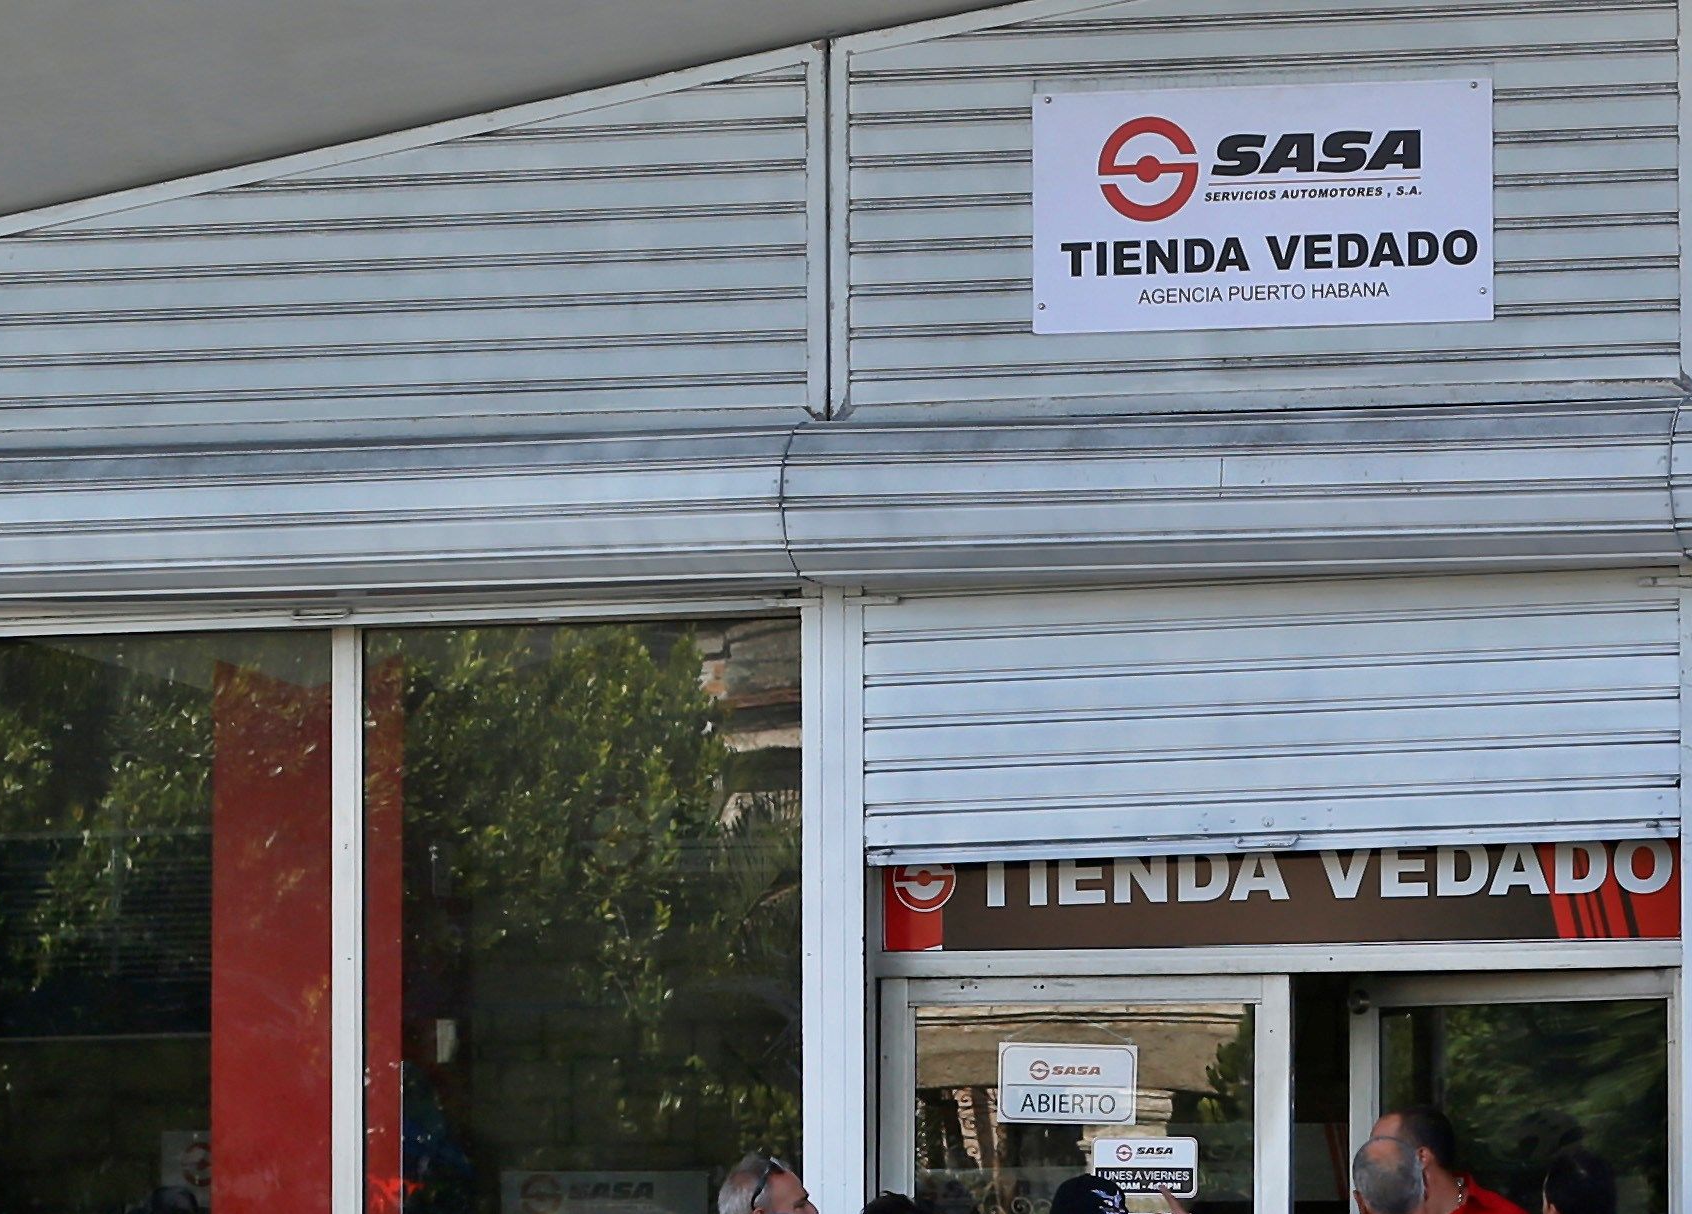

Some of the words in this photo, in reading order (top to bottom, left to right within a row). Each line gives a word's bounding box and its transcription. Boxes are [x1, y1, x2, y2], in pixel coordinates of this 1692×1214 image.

[1210, 128, 1422, 177] SASA
[1204, 190, 1277, 203] SERVICIOS
[1280, 186, 1383, 201] AUTOMOTORES
[1396, 185, 1422, 196] S.A.
[1061, 235, 1250, 278] TIENDA
[1266, 228, 1478, 271] VEDADO
[1138, 286, 1223, 305] AGENCIA
[1228, 283, 1306, 302] PUERTO
[1311, 281, 1390, 299] HABANA
[1320, 838, 1674, 899] VEDADO
[1051, 1065, 1102, 1076] SASA
[1020, 1093, 1117, 1115] ABIERTO
[1136, 1146, 1174, 1155] SASA
[1134, 1170, 1143, 1180] A
[1144, 1170, 1190, 1181] VIERNES
